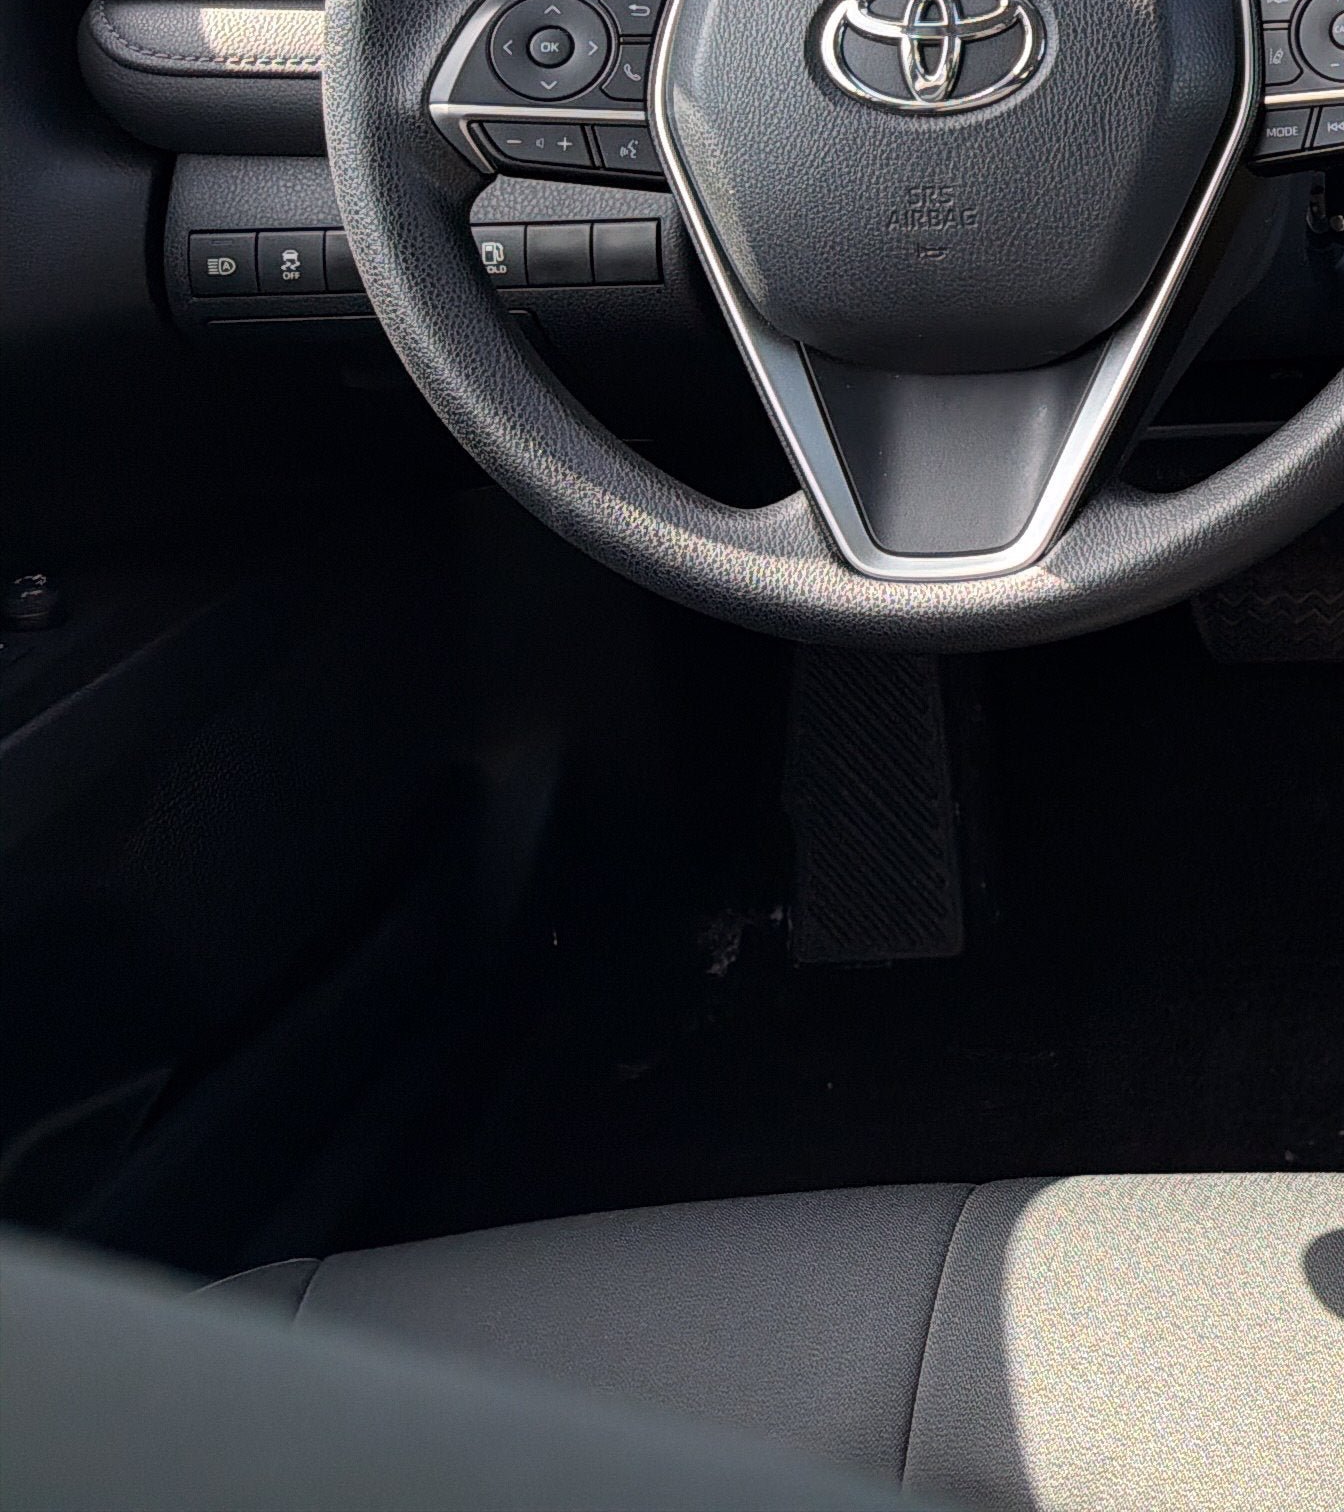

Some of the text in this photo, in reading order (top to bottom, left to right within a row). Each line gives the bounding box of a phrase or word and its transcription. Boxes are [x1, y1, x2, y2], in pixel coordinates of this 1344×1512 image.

[540, 41, 560, 53] OK
[1266, 126, 1299, 138] MODE
[907, 186, 955, 208] SRS
[888, 207, 979, 230] AIRBAG
[282, 270, 301, 280] OFF
[486, 265, 507, 274] OLD
